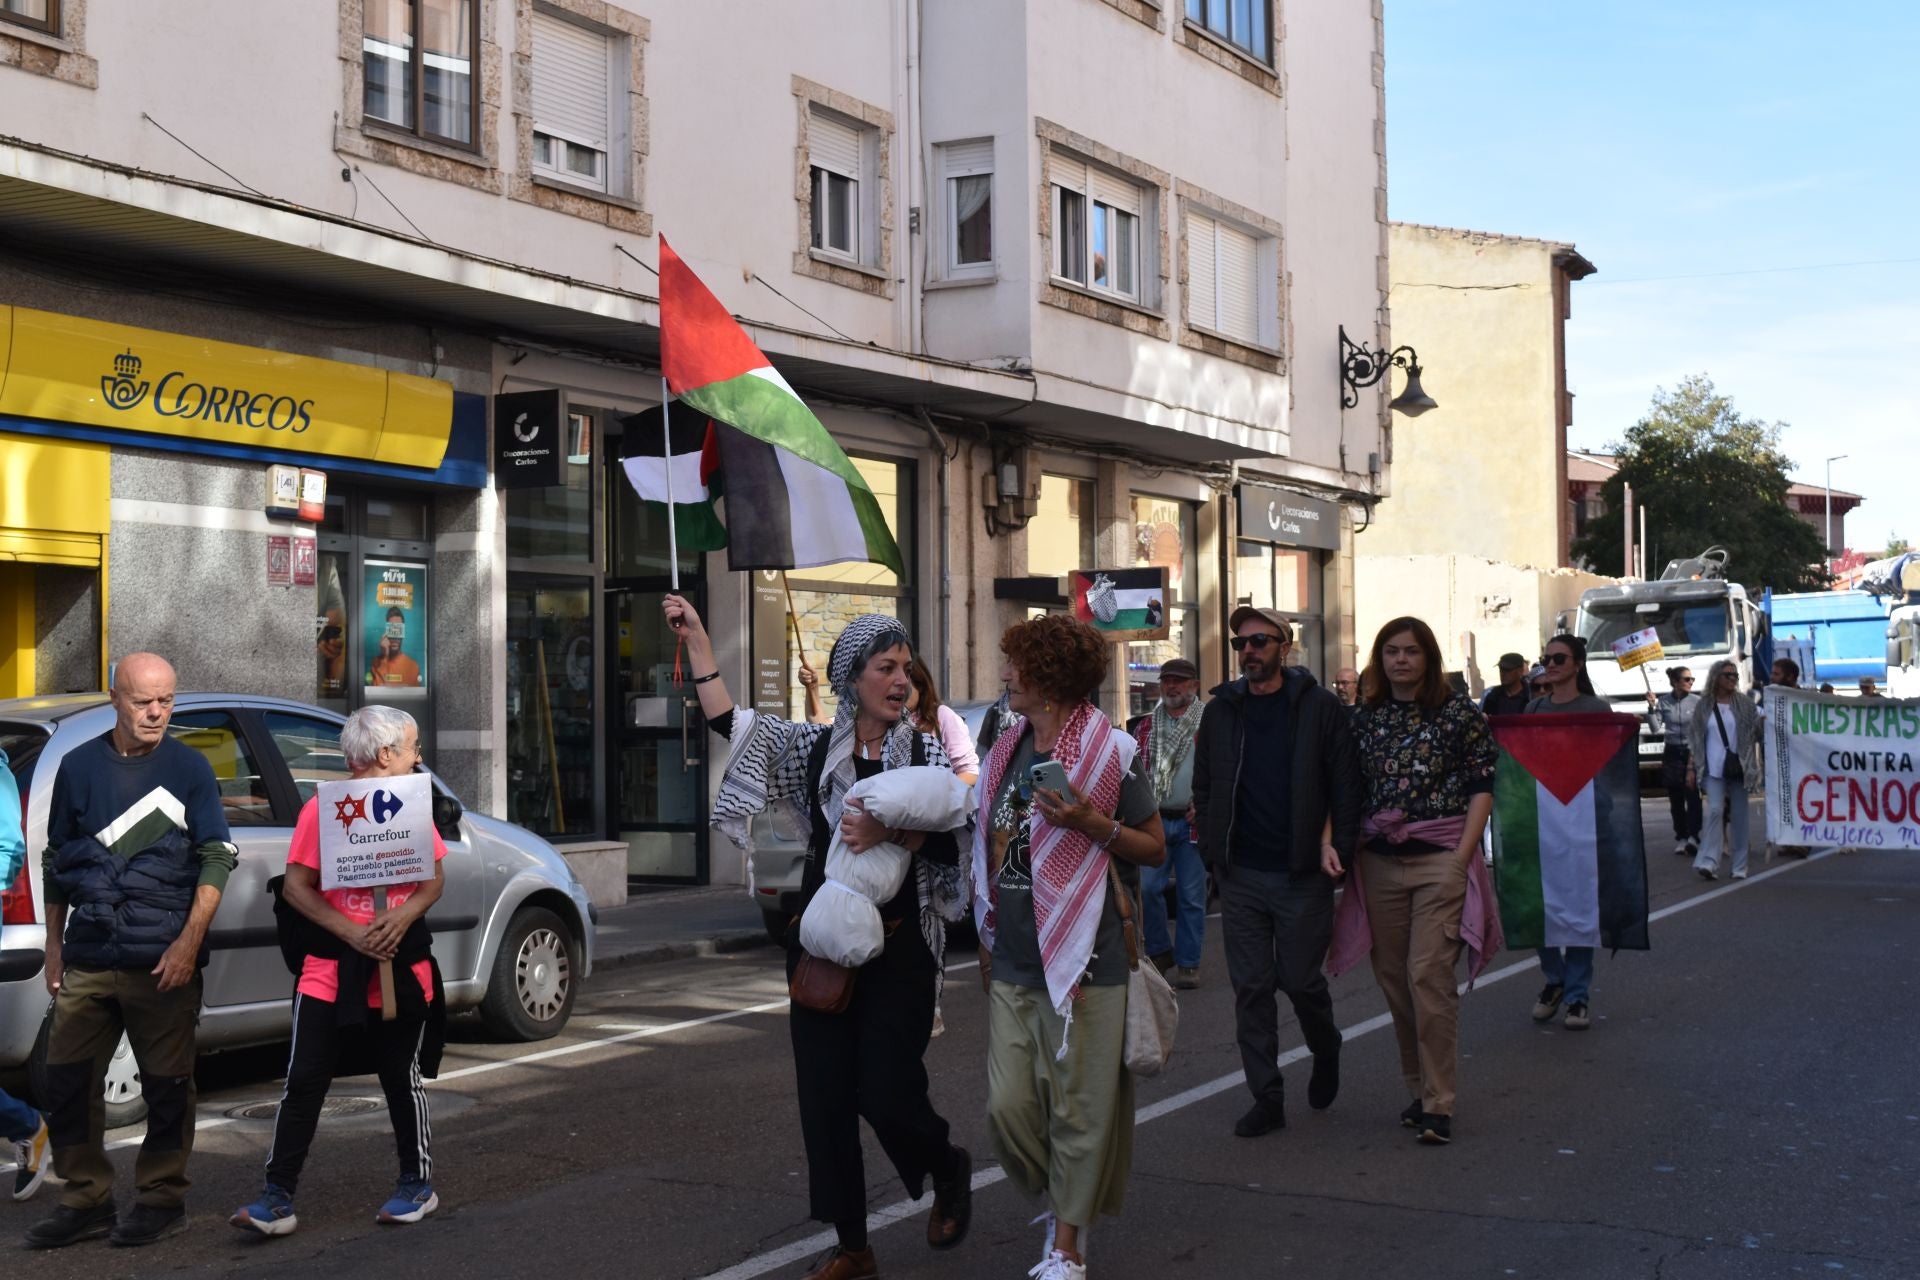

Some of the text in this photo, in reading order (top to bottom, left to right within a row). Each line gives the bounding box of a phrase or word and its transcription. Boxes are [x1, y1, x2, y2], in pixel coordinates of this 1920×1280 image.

[153, 371, 315, 433] CORREOS
[503, 448, 550, 458] Decoraciones
[515, 458, 538, 466] Carlos
[1281, 503, 1320, 521] Decoraciones
[1281, 520, 1301, 534] Carlos
[1791, 702, 1920, 739] NUESTRAS
[1828, 750, 1914, 772] CONTRA
[349, 829, 411, 845] Carrefour
[336, 848, 415, 865] apoya el genocidio
[337, 856, 424, 873] del pueblo palestino.
[337, 871, 376, 882] Pasemos
[395, 866, 424, 876] acción.
